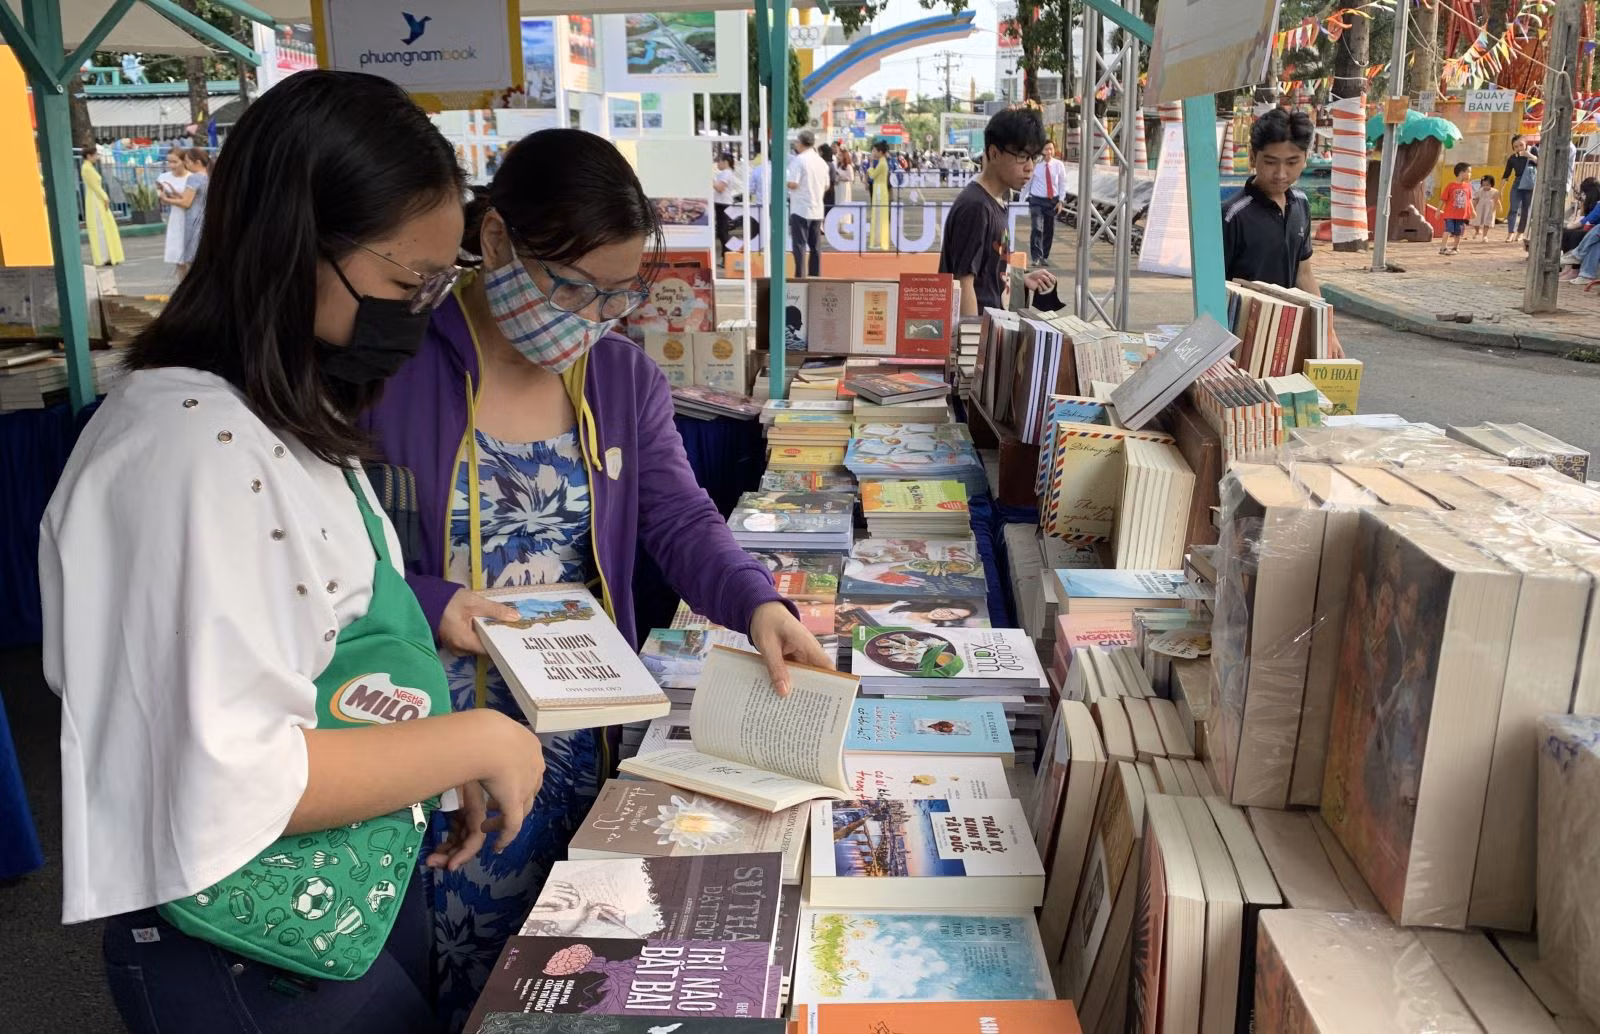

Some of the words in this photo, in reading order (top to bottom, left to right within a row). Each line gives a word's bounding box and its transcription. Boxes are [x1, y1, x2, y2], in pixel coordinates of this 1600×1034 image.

[359, 46, 477, 67] phuongnambook
[345, 684, 420, 721] MILO
[944, 816, 963, 834] TÂY
[963, 816, 982, 839] KINH
[635, 945, 686, 980] BẤT
[686, 945, 728, 972] TRÍ
[677, 977, 722, 1013] NÃO
